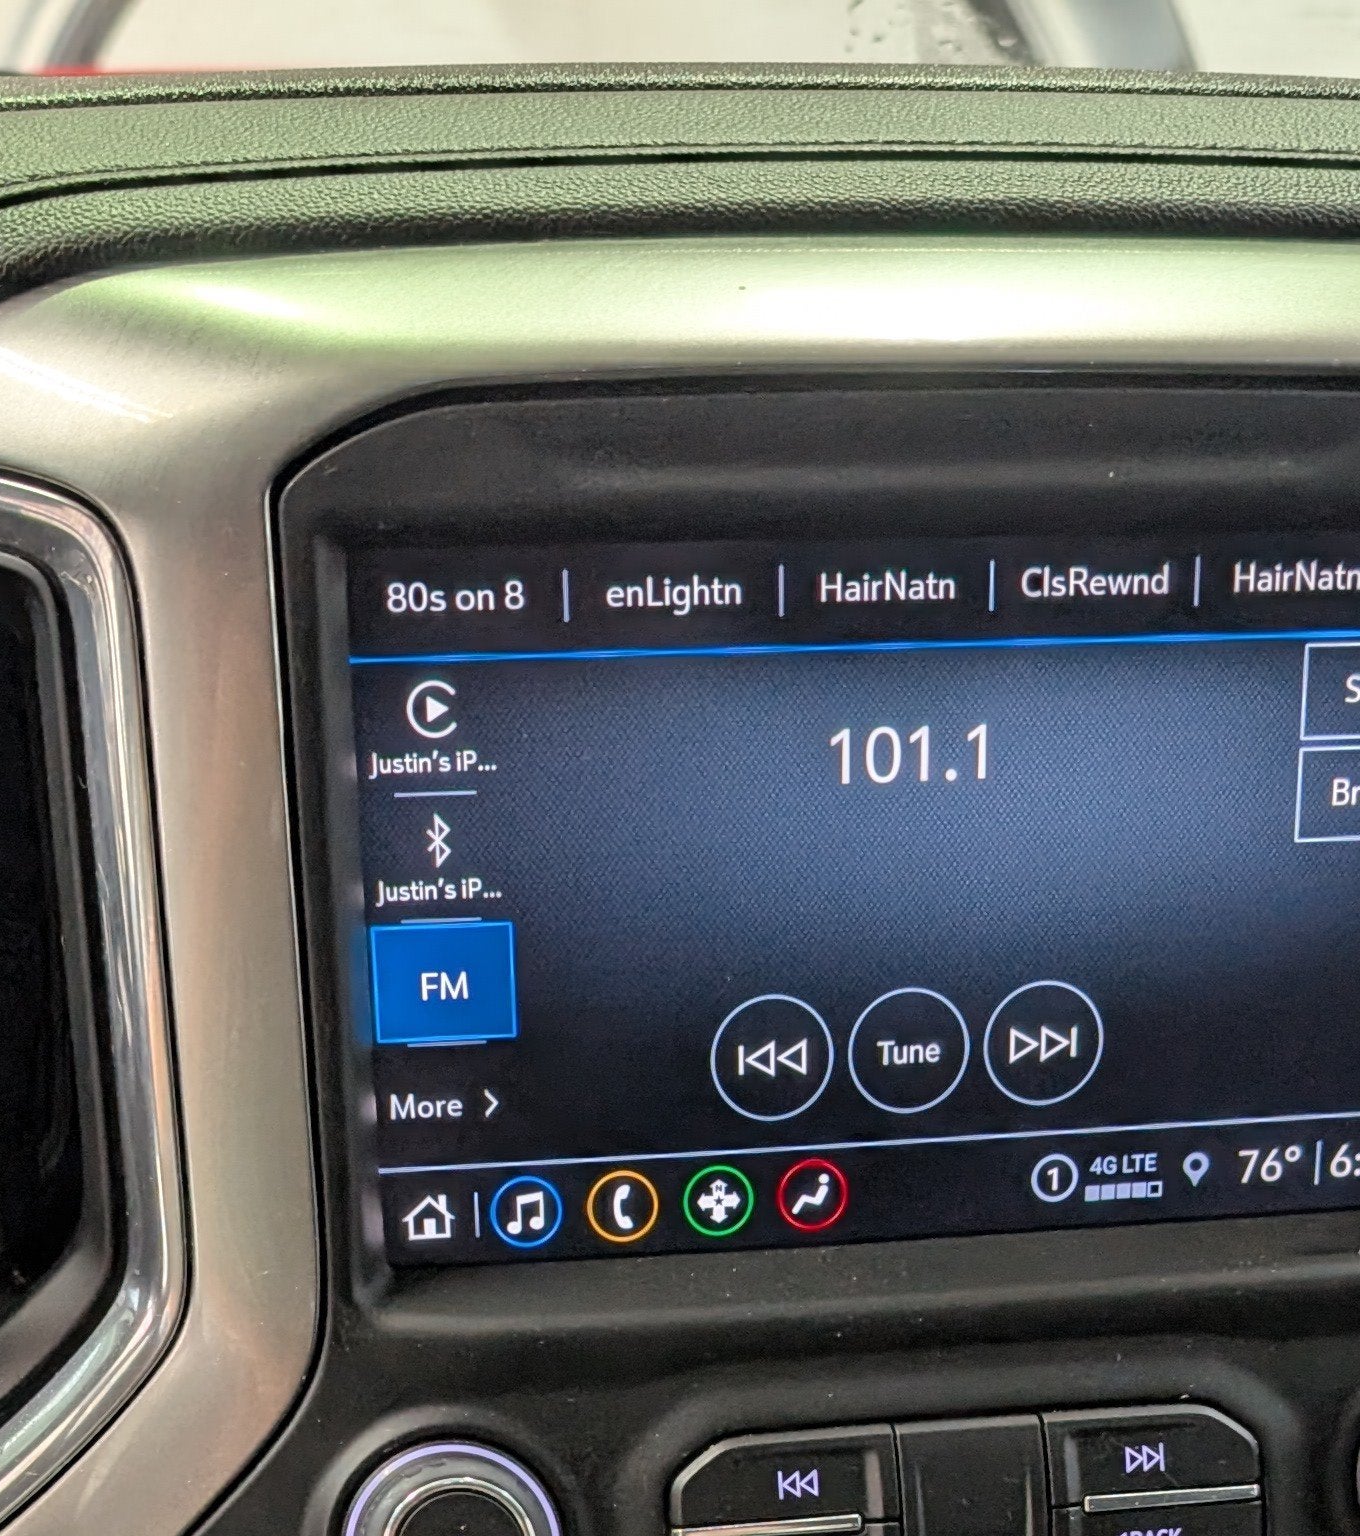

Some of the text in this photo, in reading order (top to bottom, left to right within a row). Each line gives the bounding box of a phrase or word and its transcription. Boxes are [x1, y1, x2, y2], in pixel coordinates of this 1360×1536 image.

[386, 580, 525, 613] 80s on 8
[606, 574, 742, 616] enLightn
[820, 569, 956, 603] HairNatn
[1021, 562, 1170, 598] ClsRewnd
[830, 723, 987, 785] 101.1
[421, 970, 469, 1002] FM
[876, 1040, 941, 1066] Tune
[390, 1093, 463, 1120] More
[1089, 1152, 1158, 1175] 4G LTE
